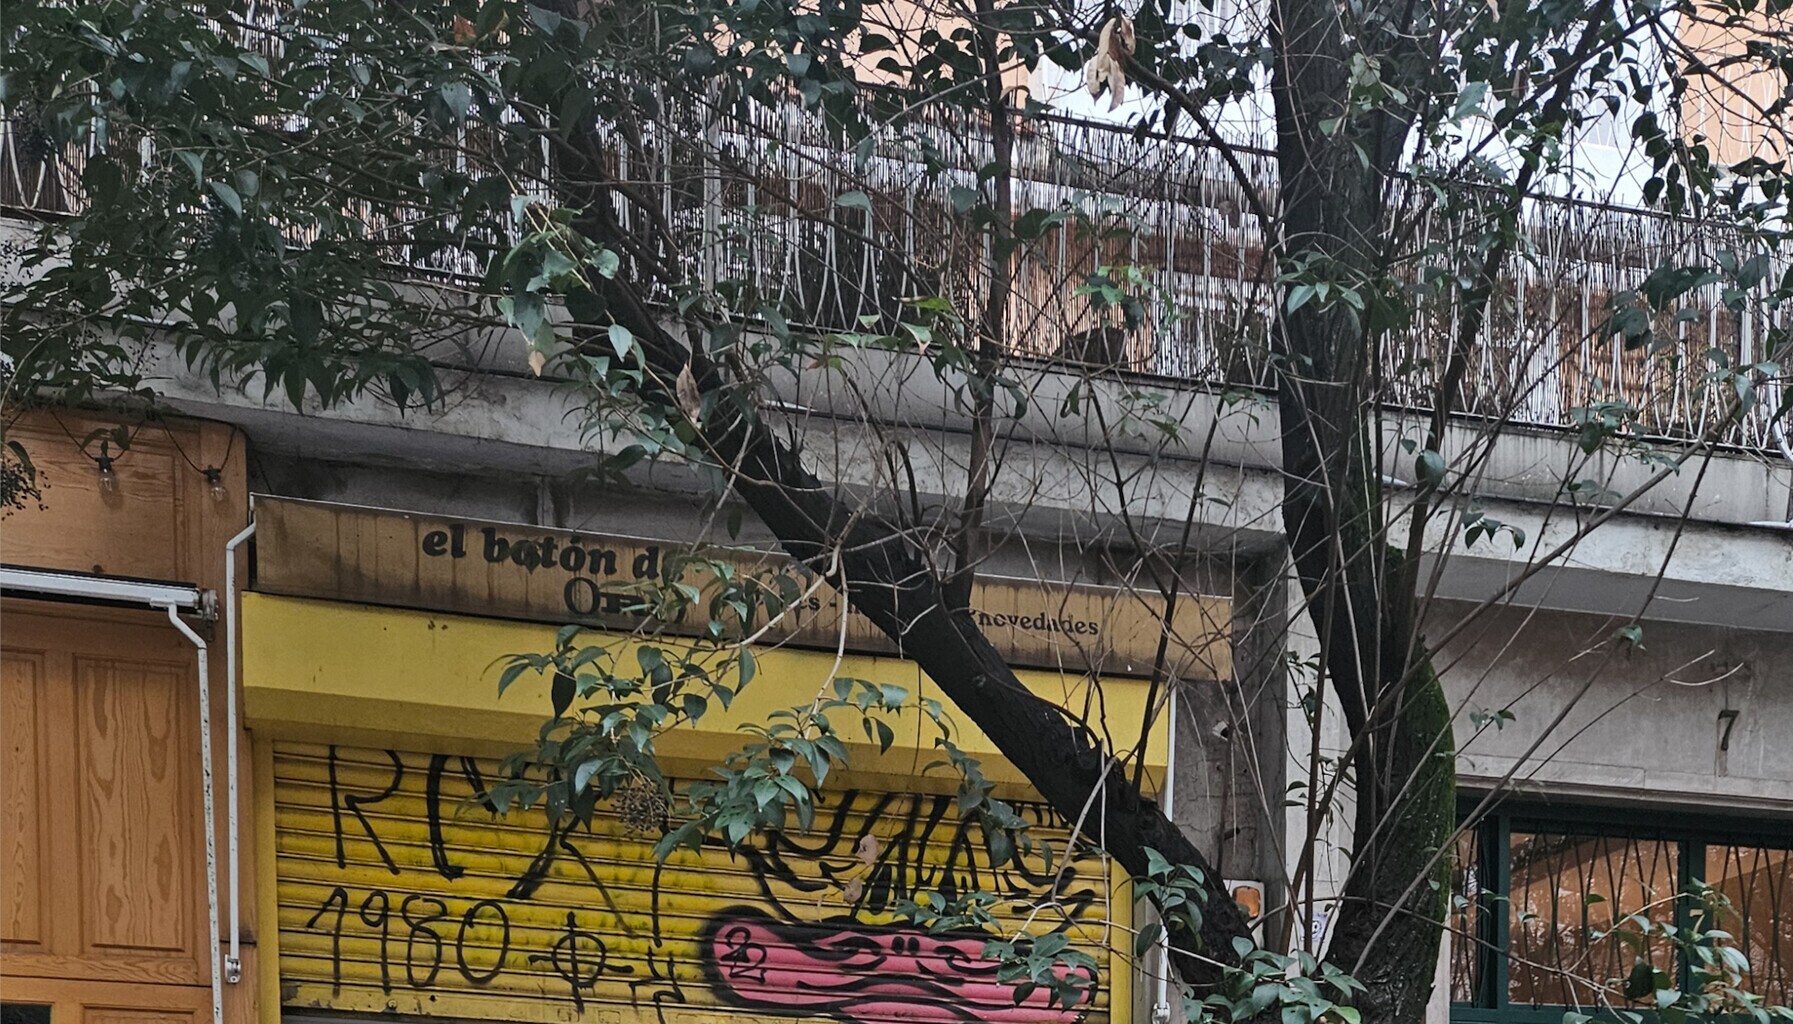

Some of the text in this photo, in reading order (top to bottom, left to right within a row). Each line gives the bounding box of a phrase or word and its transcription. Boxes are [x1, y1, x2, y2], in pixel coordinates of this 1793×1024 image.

[422, 523, 466, 558] el
[632, 546, 685, 582] d
[978, 611, 1099, 635] novedades
[1717, 709, 1740, 751] 7
